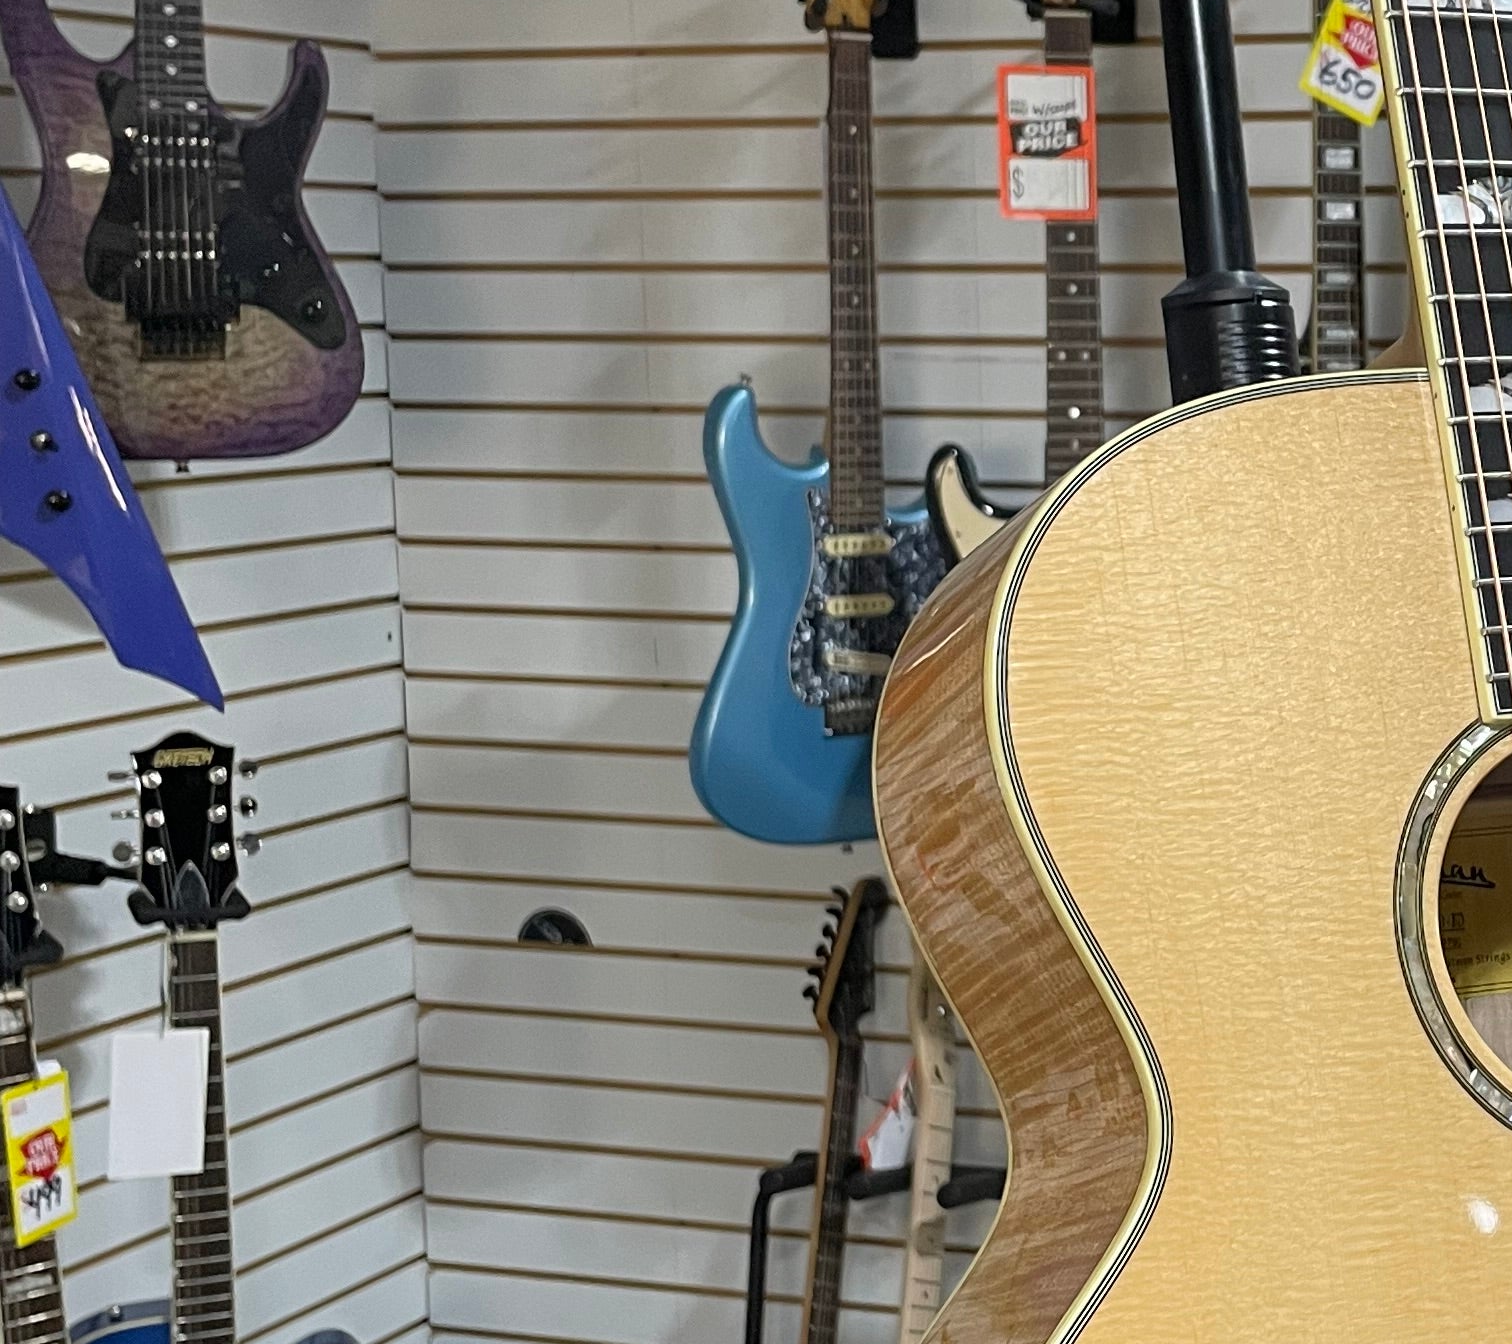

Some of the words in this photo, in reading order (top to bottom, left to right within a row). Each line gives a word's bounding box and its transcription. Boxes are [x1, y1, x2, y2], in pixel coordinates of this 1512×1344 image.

[1023, 120, 1068, 138] OUR
[1015, 131, 1079, 154] PRICE
[1476, 952, 1511, 965] Strings
